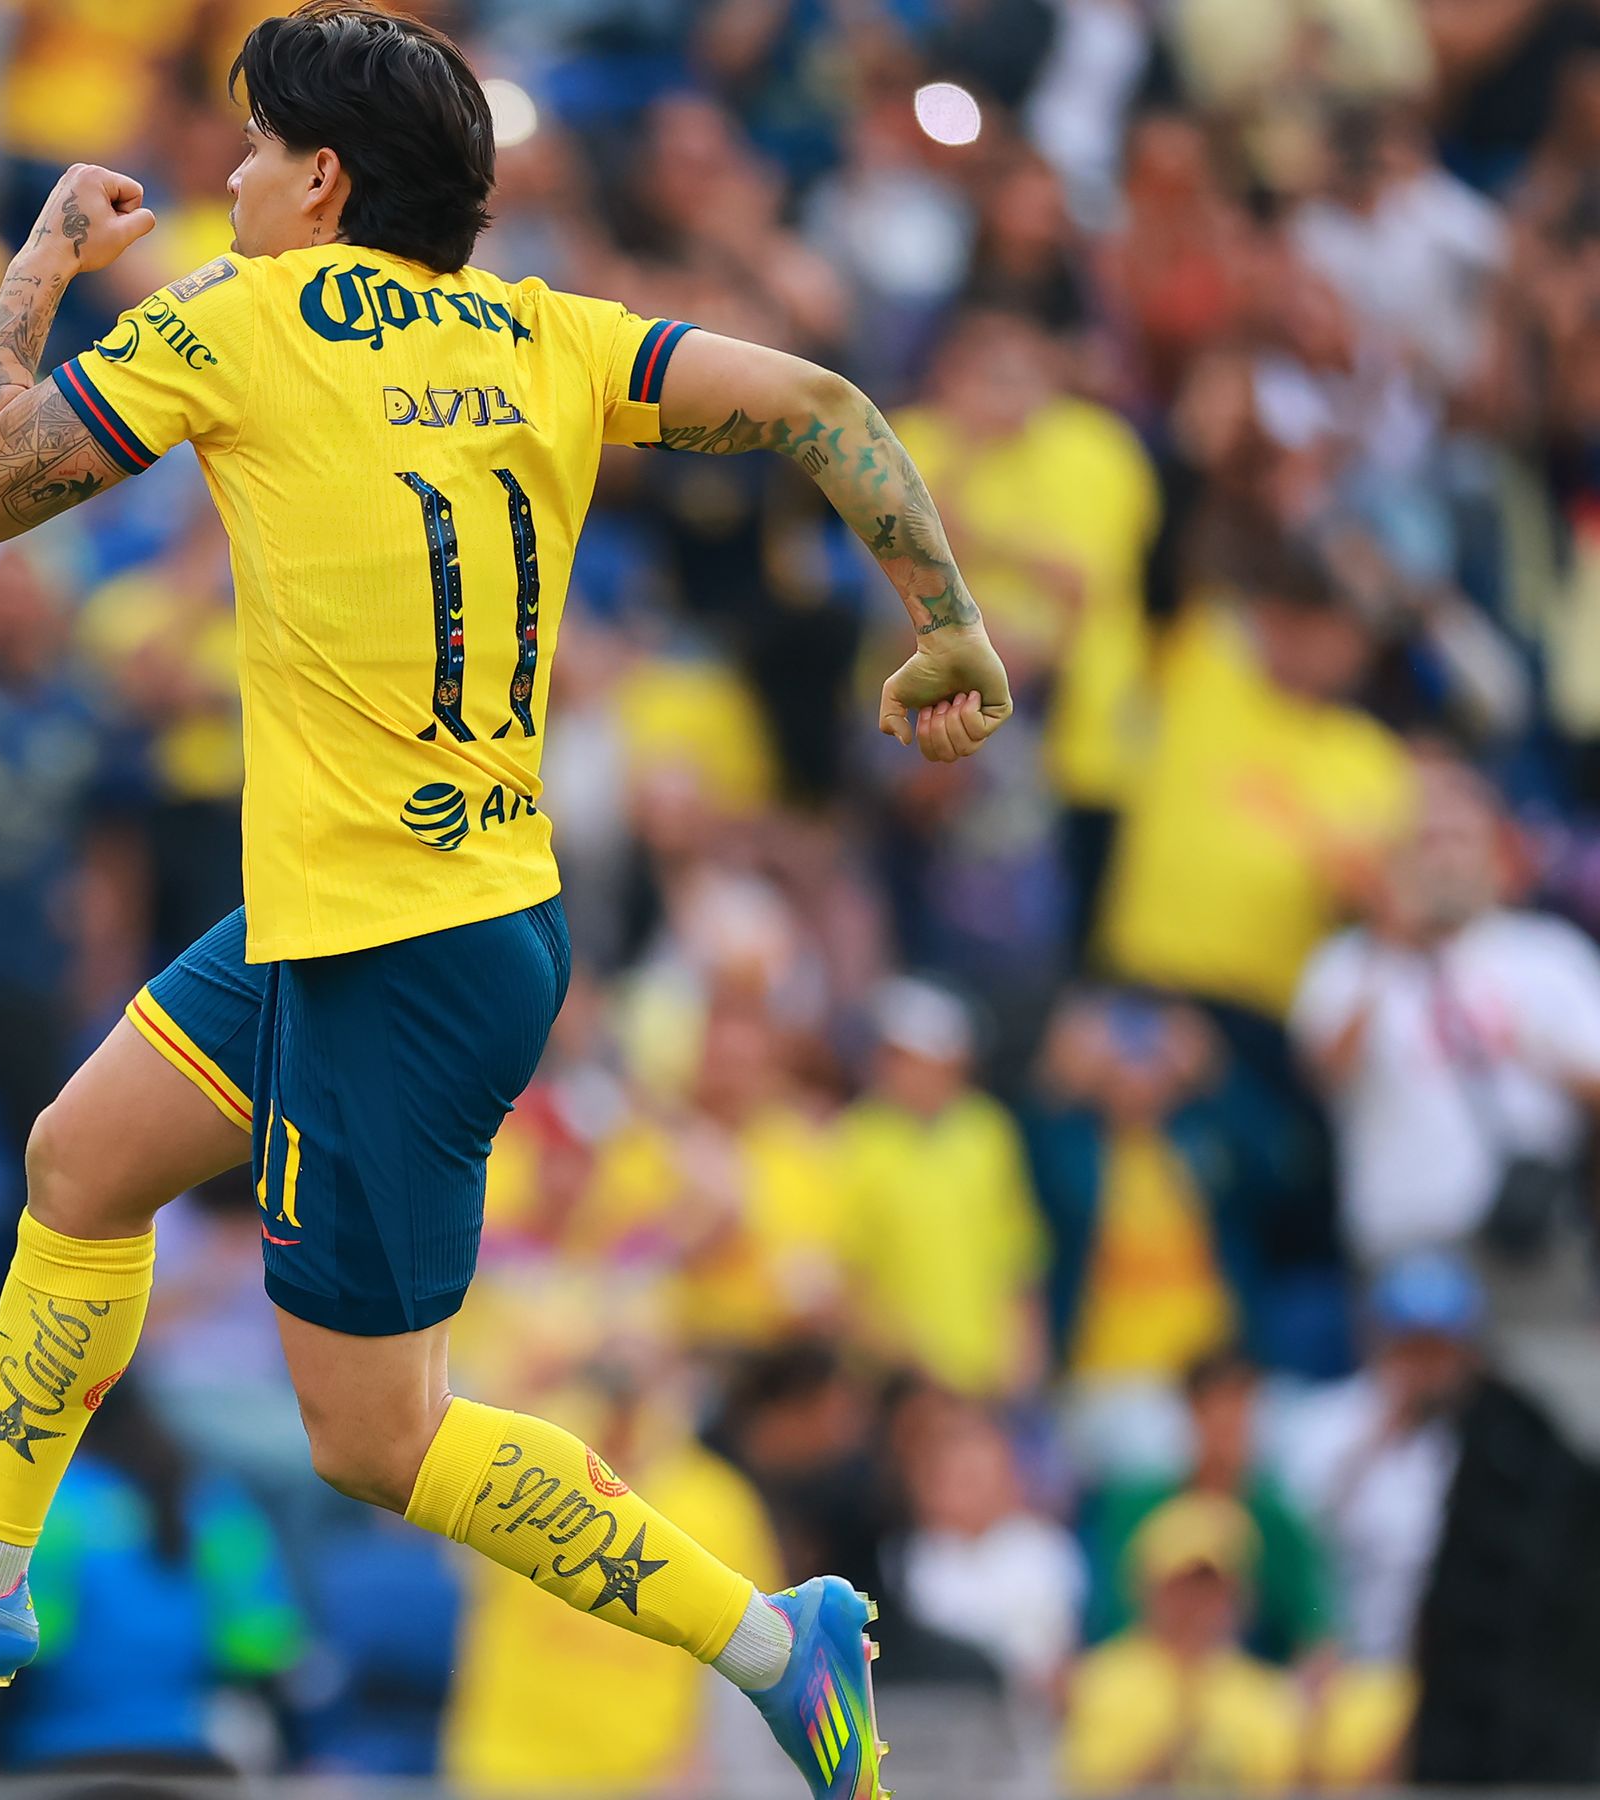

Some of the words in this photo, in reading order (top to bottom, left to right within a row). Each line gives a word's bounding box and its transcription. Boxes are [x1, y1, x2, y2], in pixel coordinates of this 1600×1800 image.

[383, 380, 528, 428] DAVIL
[394, 468, 537, 743] 11
[0, 1292, 92, 1417] Carl's
[490, 1466, 618, 1578] Carl's
